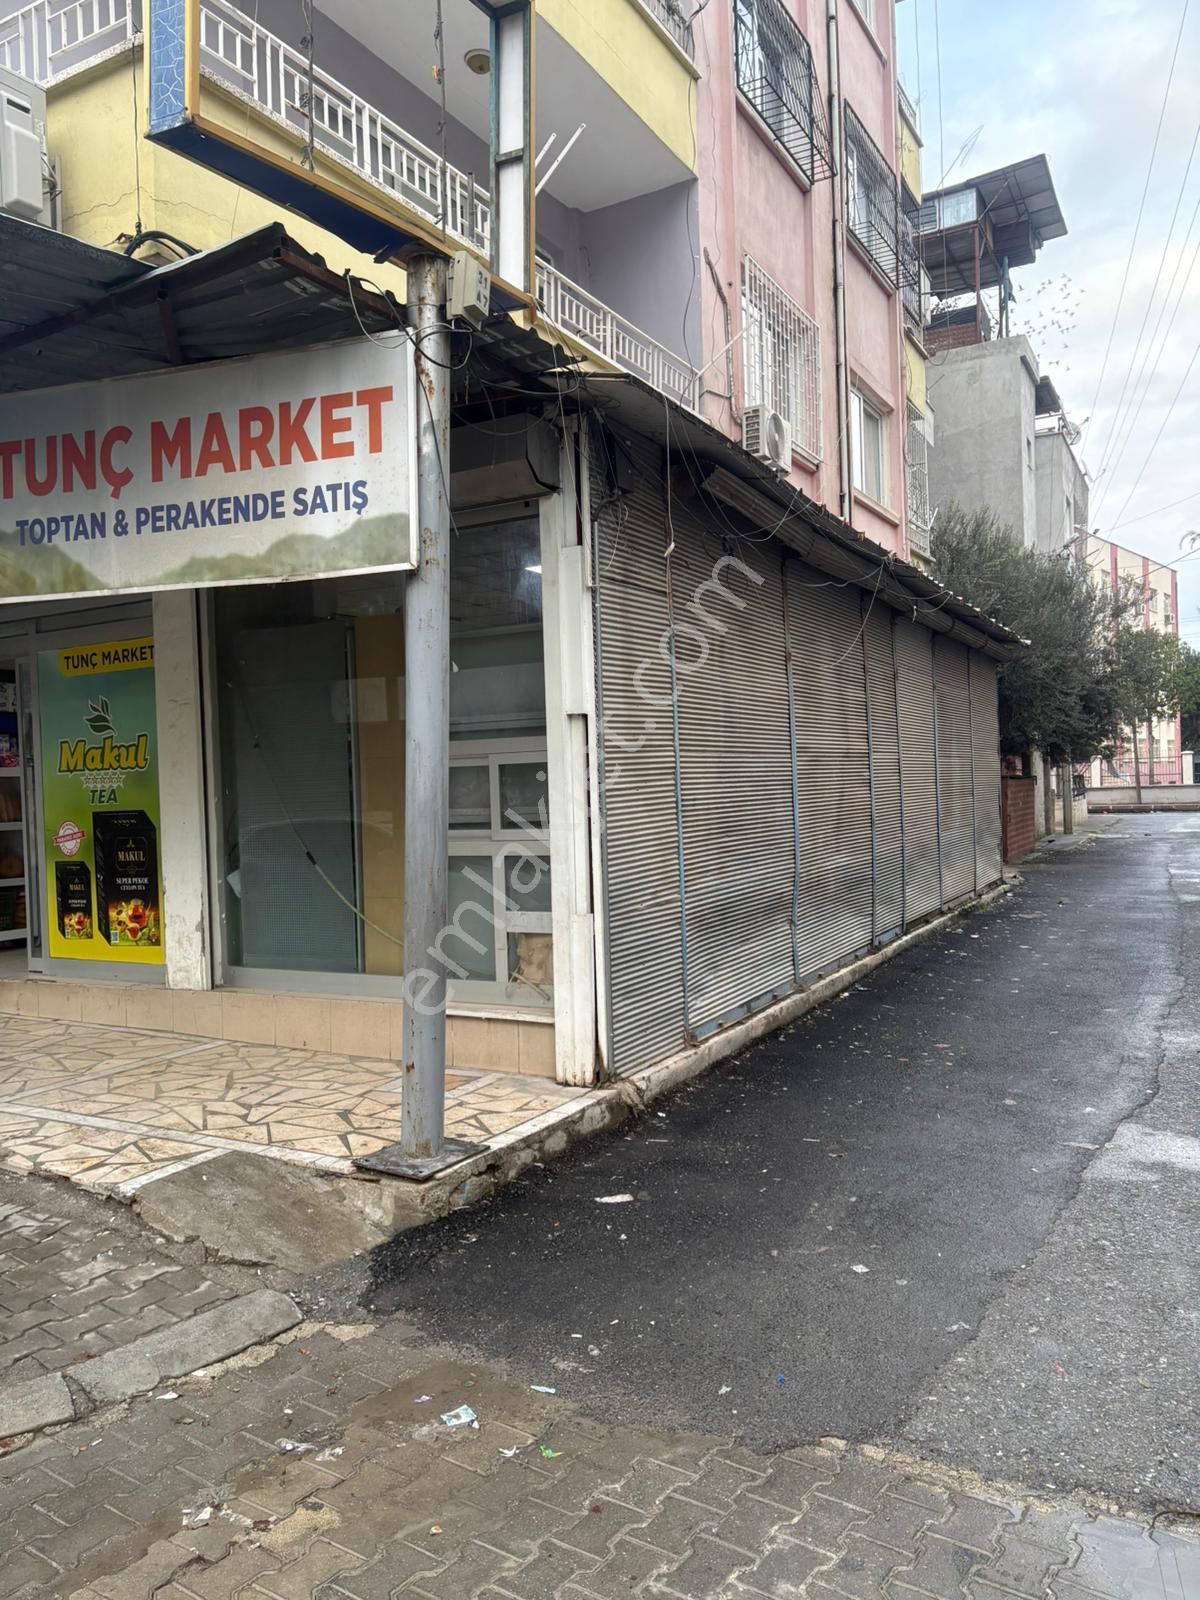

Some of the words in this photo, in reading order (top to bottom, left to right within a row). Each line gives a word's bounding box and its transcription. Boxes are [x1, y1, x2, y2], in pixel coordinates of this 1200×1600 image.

[0, 425, 134, 499] TUNÇ
[151, 386, 393, 482] MARKET
[16, 511, 106, 546] TOPTAN
[113, 514, 129, 537] &
[136, 490, 285, 535] PERAKENDE
[293, 480, 369, 516] SATIŞ
[64, 652, 98, 670] TUNÇ
[102, 645, 155, 665] MARKET
[58, 733, 148, 773] Makul
[89, 788, 118, 804] TEA
[118, 851, 146, 861] MAKUL
